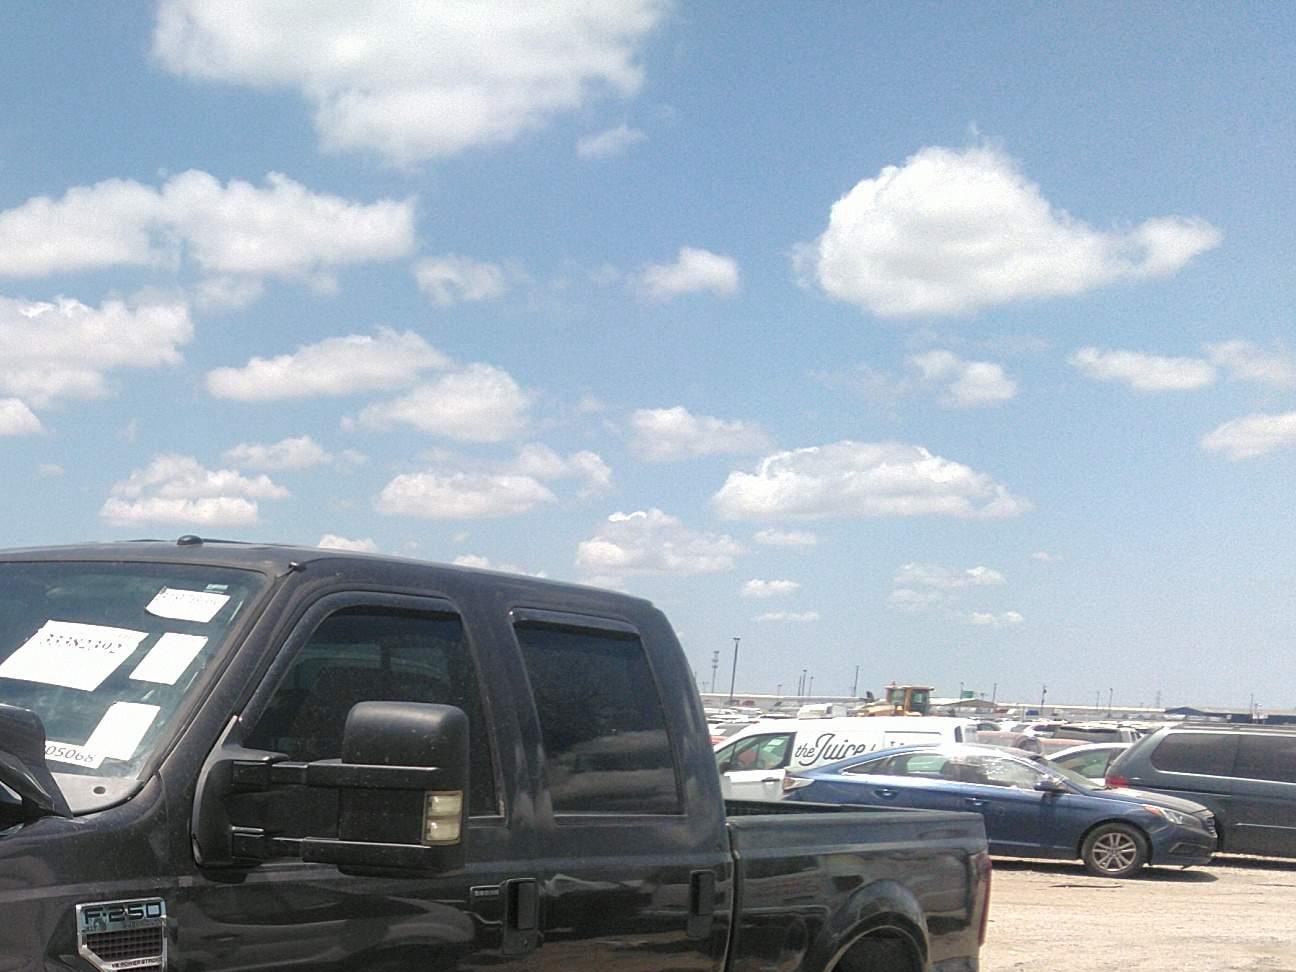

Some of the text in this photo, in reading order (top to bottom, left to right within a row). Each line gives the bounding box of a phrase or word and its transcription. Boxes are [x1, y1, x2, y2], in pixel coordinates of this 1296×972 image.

[794, 743, 816, 758] the
[798, 732, 867, 766] Juice
[83, 902, 162, 925] F-250
